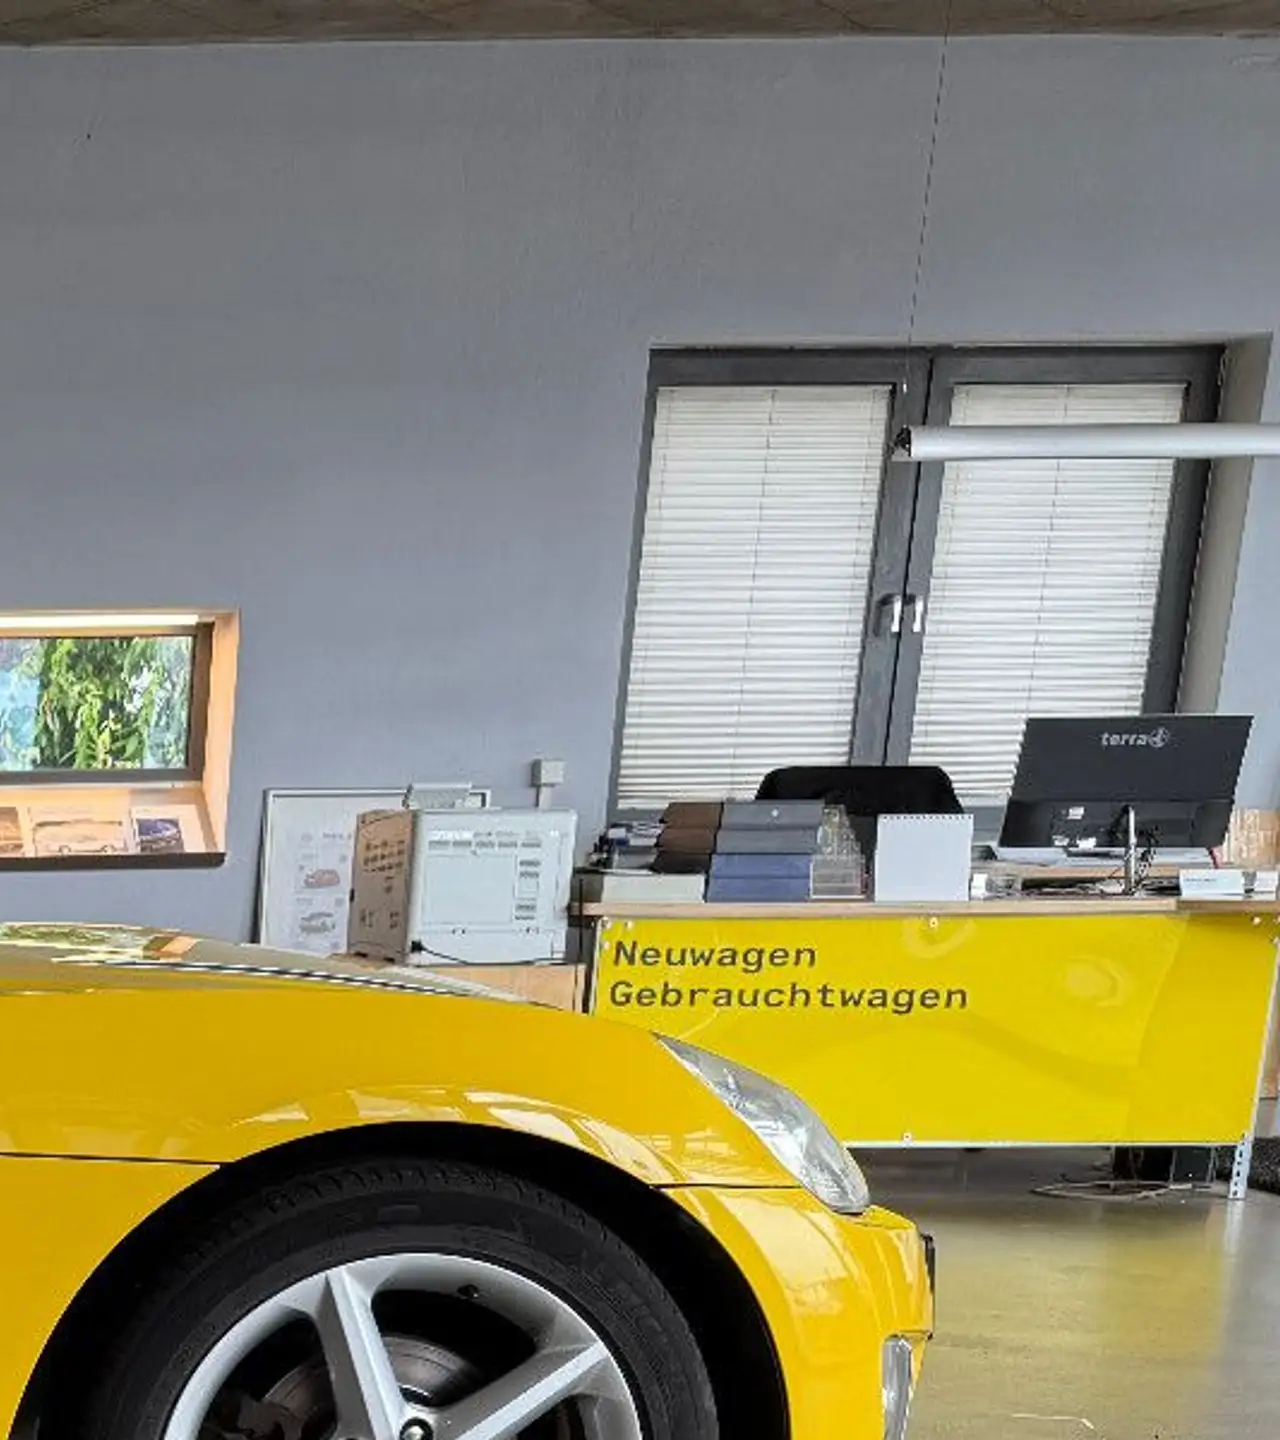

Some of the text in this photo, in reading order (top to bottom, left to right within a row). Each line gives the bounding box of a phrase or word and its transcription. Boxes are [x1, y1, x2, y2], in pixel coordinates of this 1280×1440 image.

[1101, 731, 1147, 745] terra
[613, 940, 816, 973] Neuwagen
[610, 980, 969, 1014] Gebrauchtwagen
